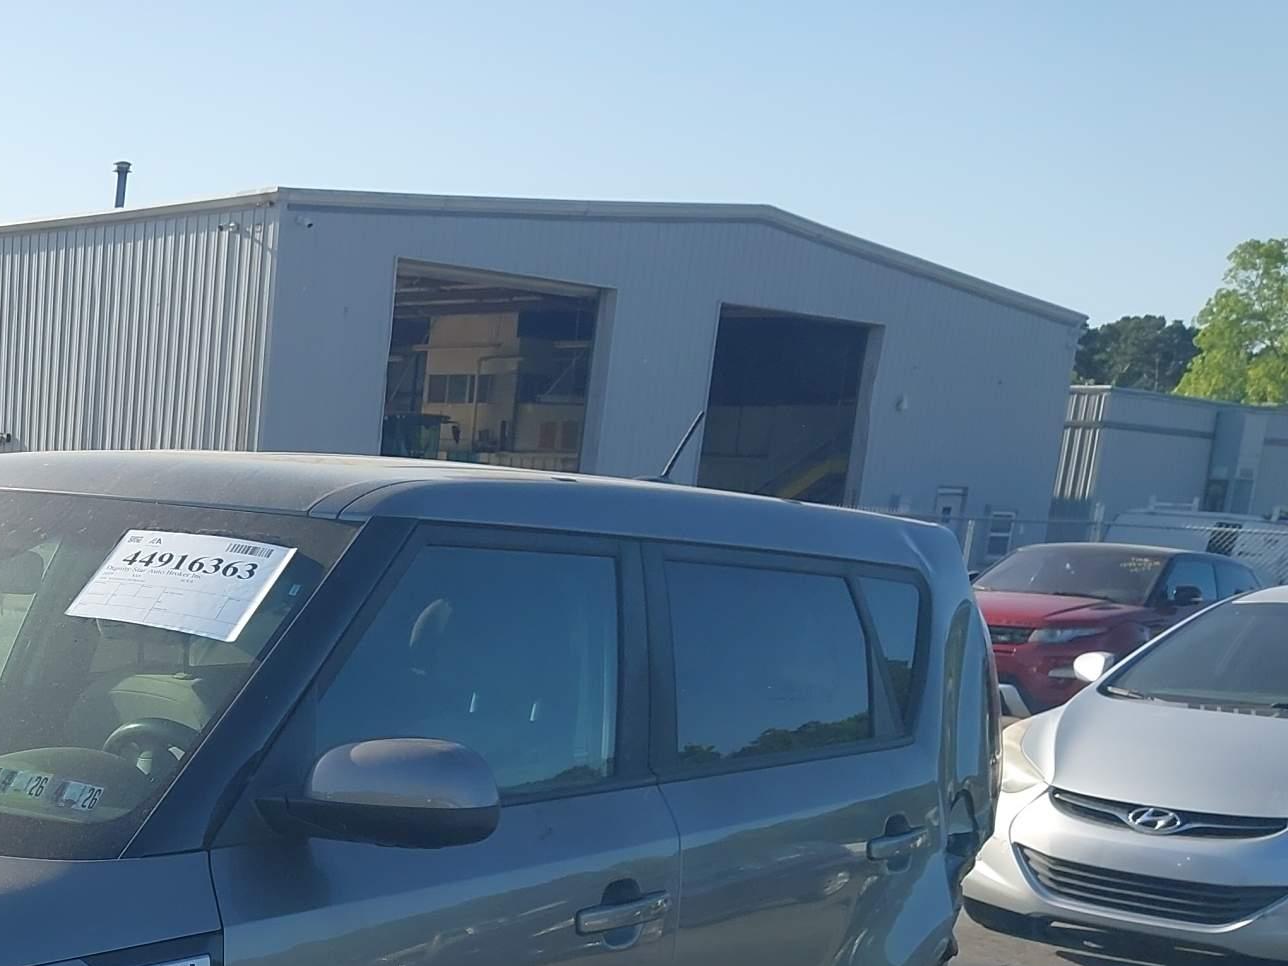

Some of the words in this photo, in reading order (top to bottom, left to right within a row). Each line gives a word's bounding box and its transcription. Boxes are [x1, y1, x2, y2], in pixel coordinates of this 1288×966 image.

[122, 550, 259, 580] 44916363
[28, 776, 49, 797] 26
[81, 787, 102, 810] 26
